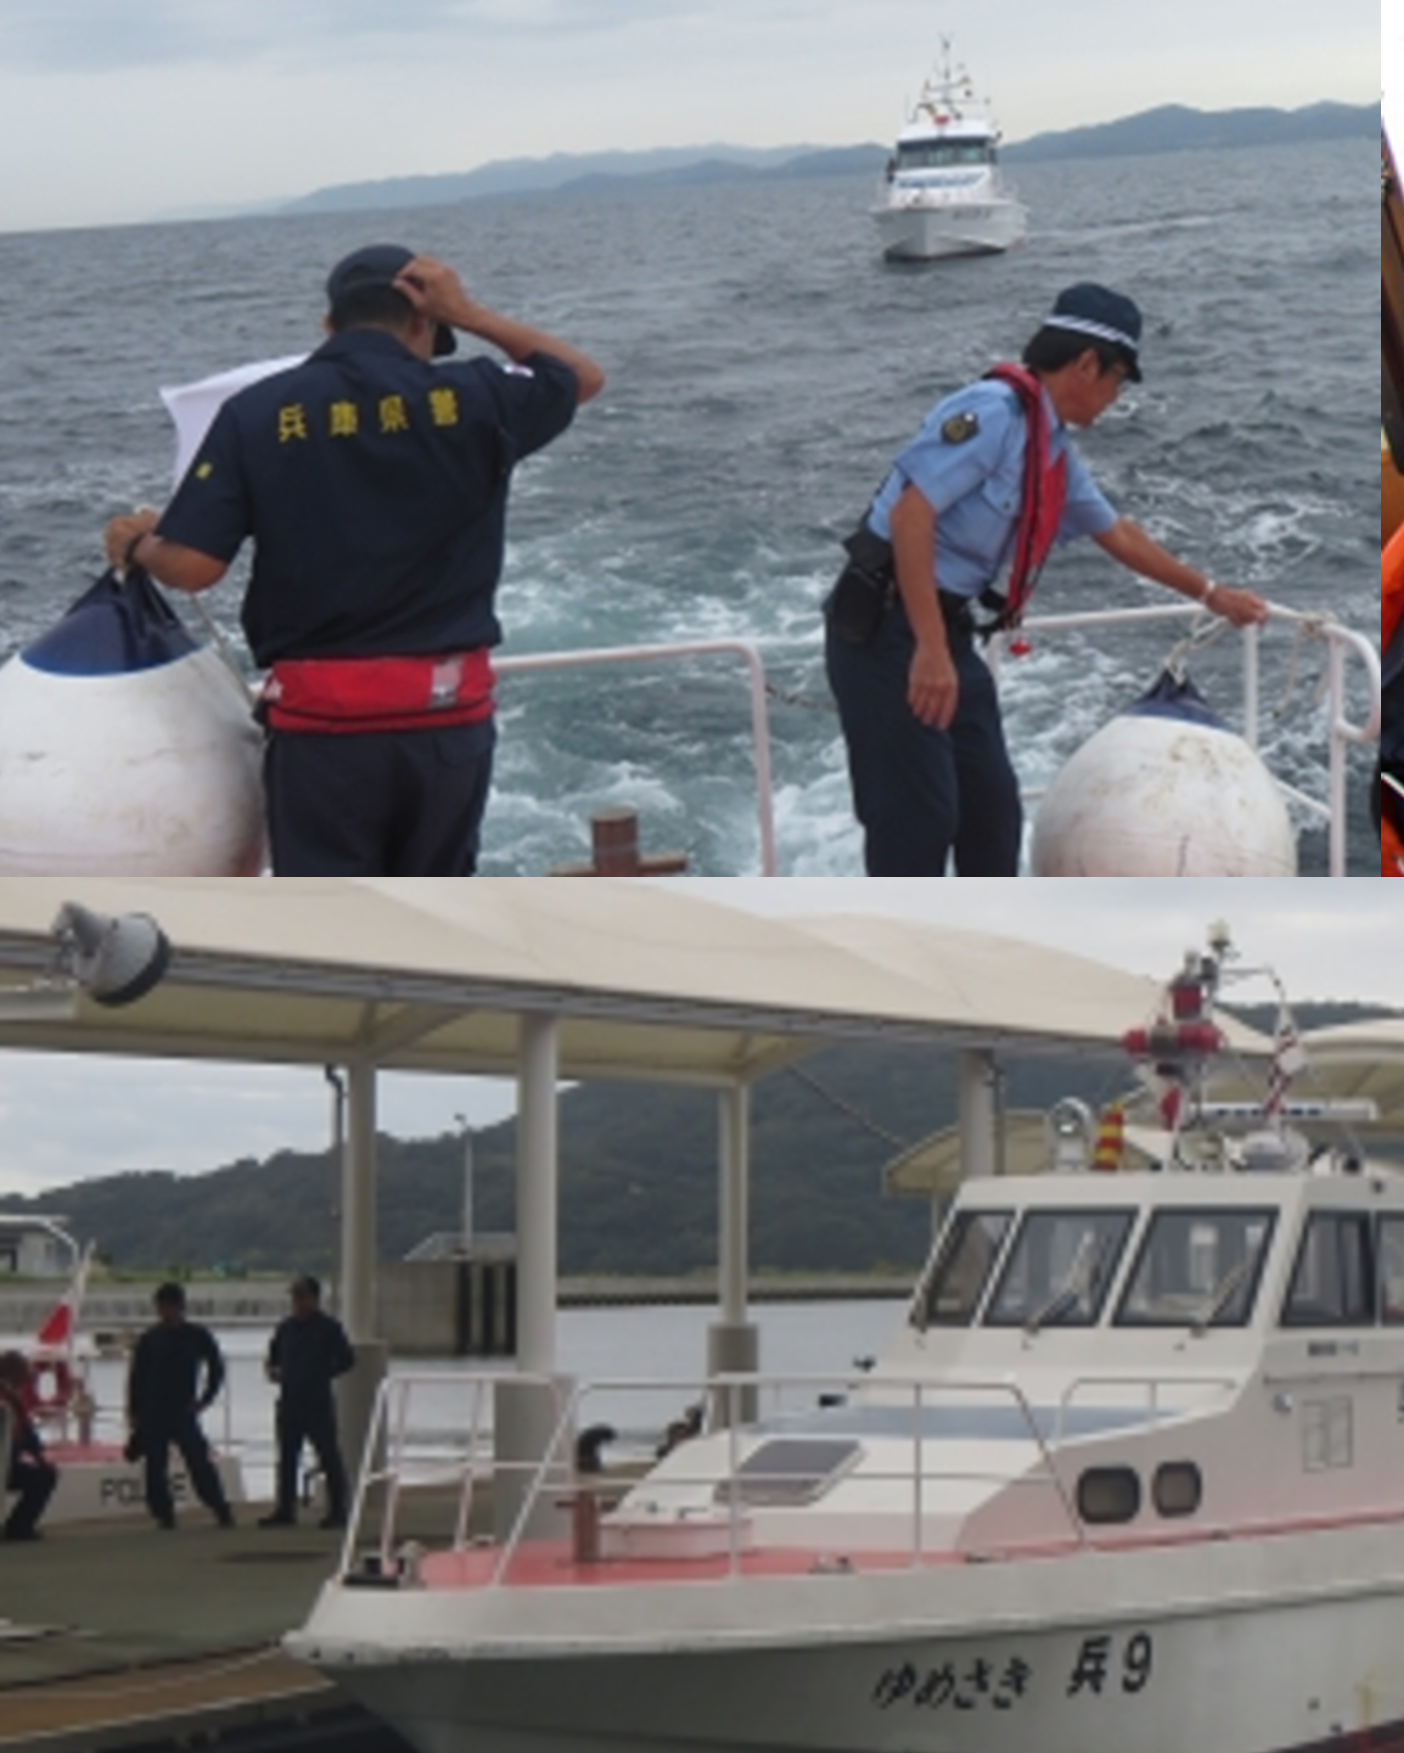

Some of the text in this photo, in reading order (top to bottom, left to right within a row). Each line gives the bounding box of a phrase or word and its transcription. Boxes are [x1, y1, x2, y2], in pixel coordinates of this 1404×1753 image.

[278, 387, 457, 441] 兵庫県警
[102, 1473, 187, 1506] POLE
[869, 1660, 1032, 1710] ゆめさき
